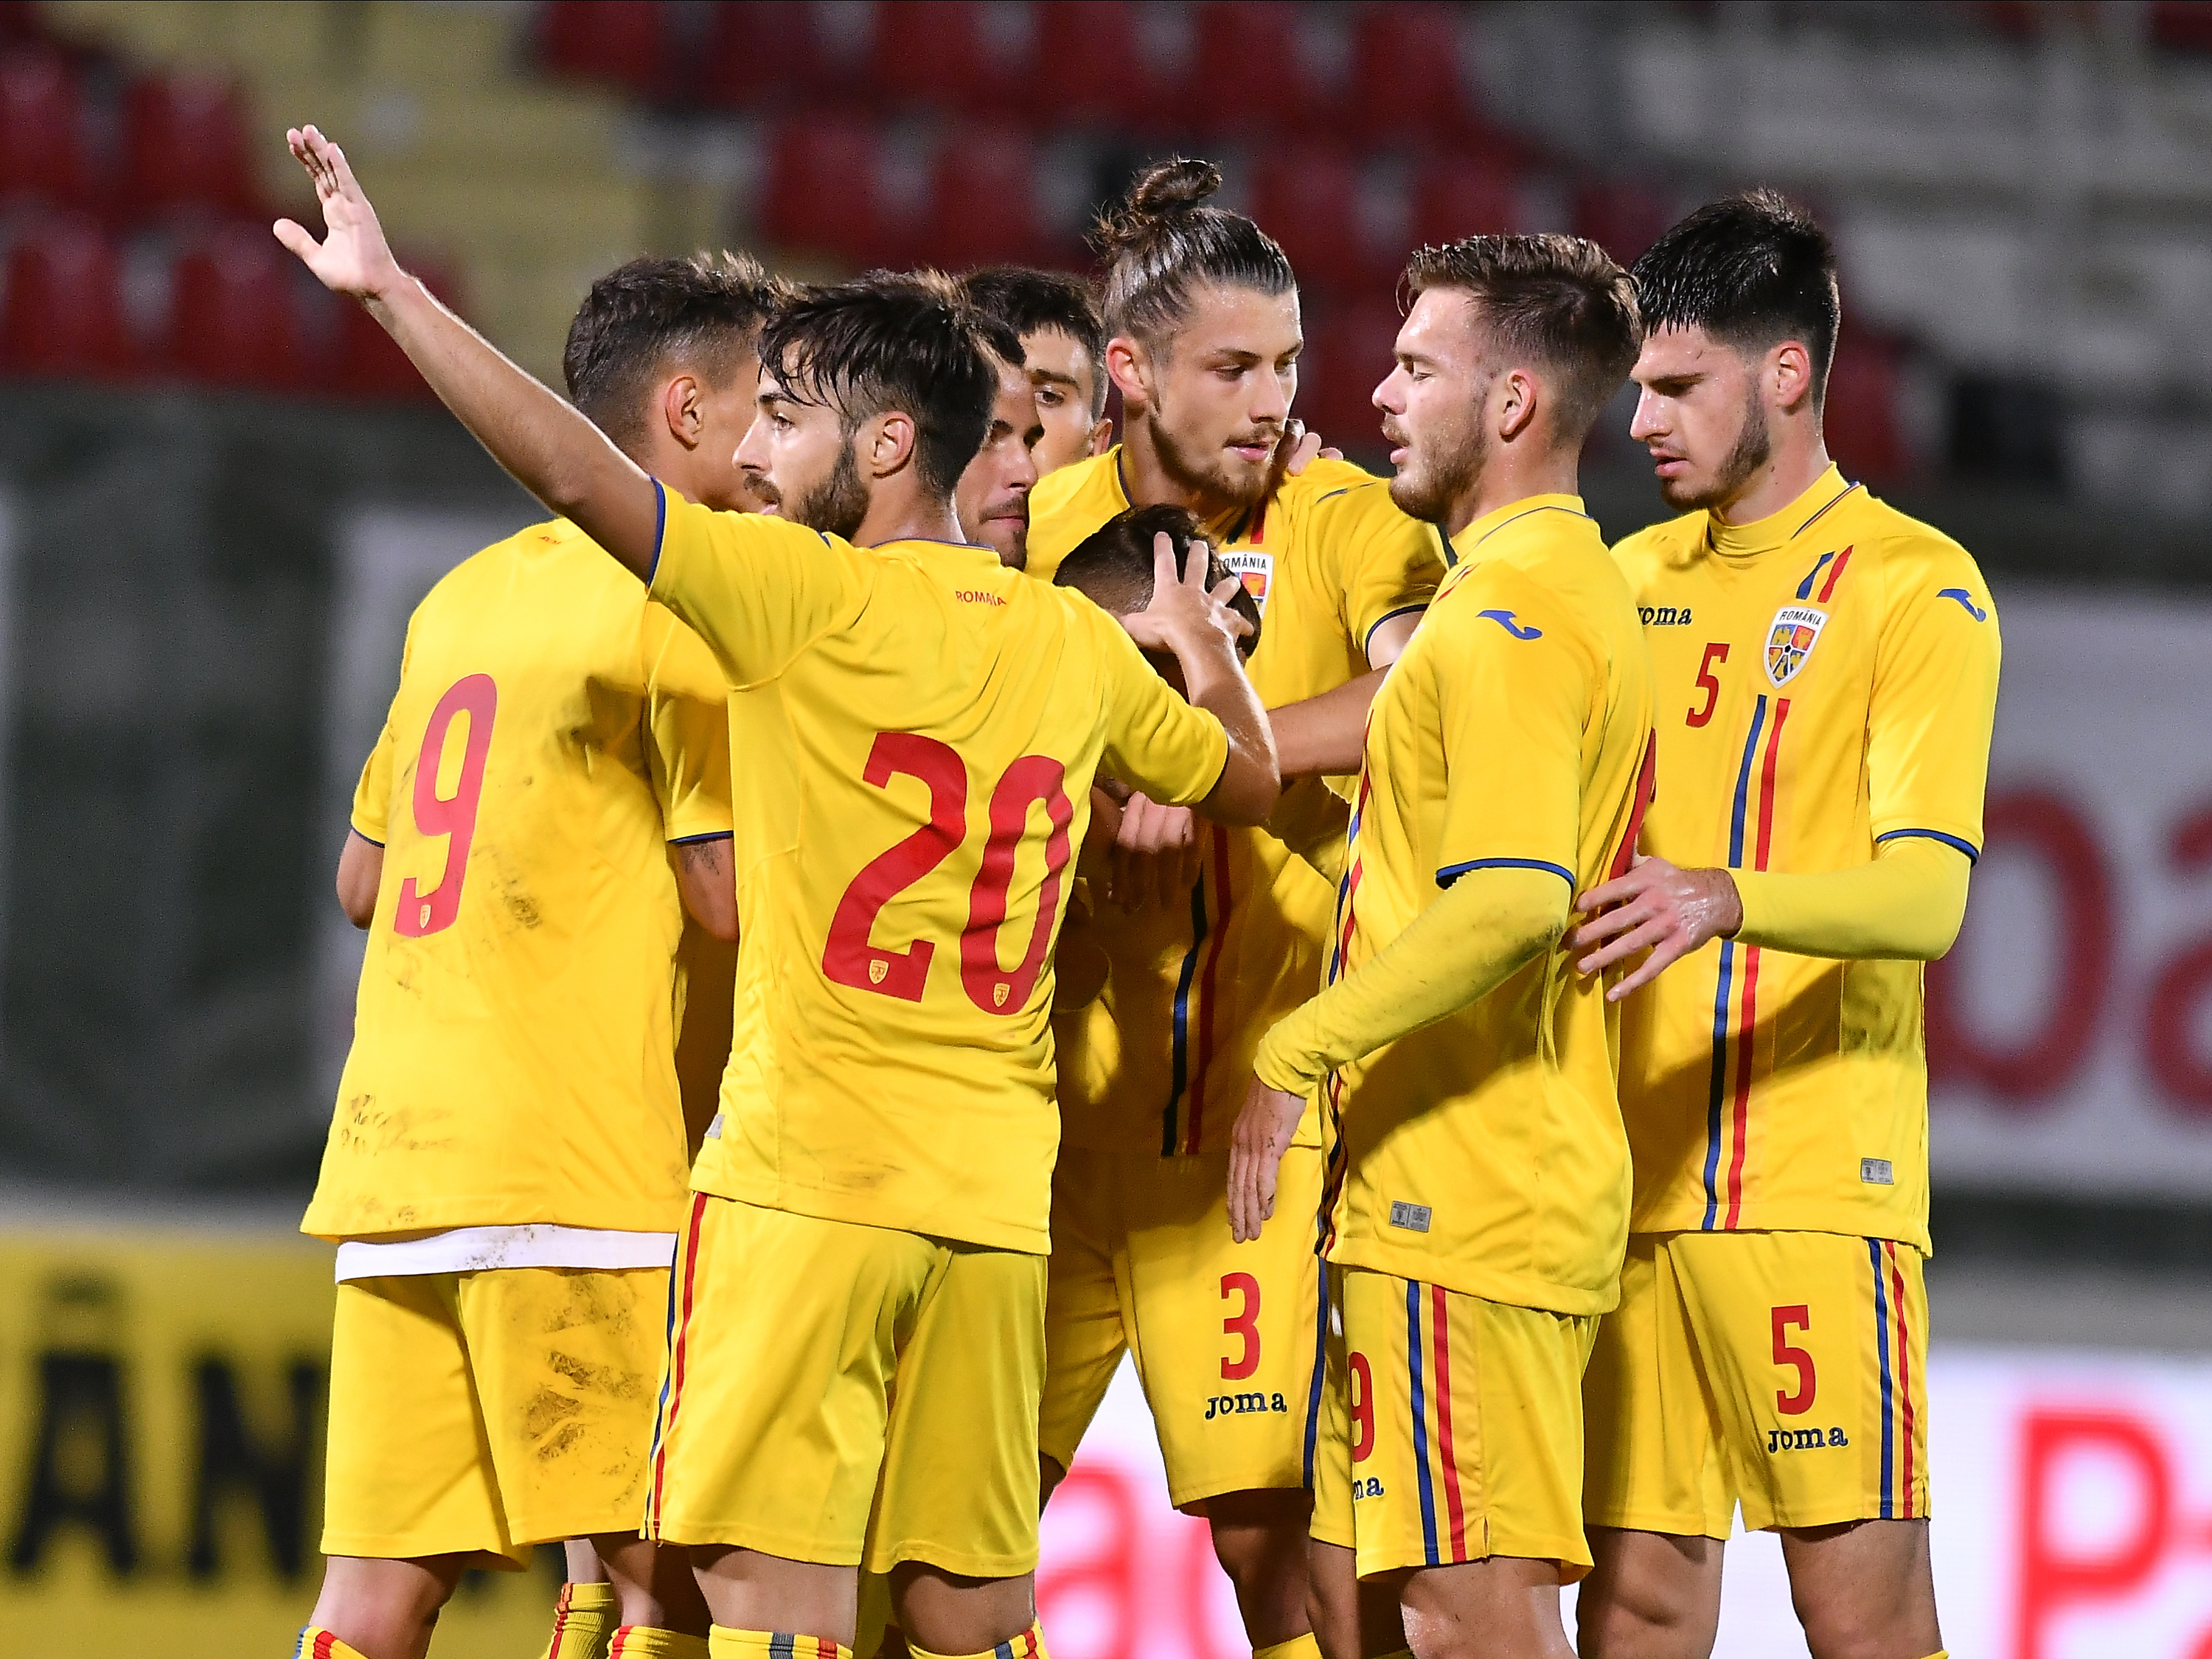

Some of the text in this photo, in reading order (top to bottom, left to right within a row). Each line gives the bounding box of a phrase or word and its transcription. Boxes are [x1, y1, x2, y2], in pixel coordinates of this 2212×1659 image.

[1223, 553, 1267, 570] OMÂNIA
[1779, 609, 1822, 627] ROMÂNIA
[1685, 642, 1731, 728] 5
[394, 672, 497, 938] 9
[821, 731, 1074, 1016] 20
[1220, 1272, 1260, 1380] 3
[1771, 1304, 1816, 1415] 5
